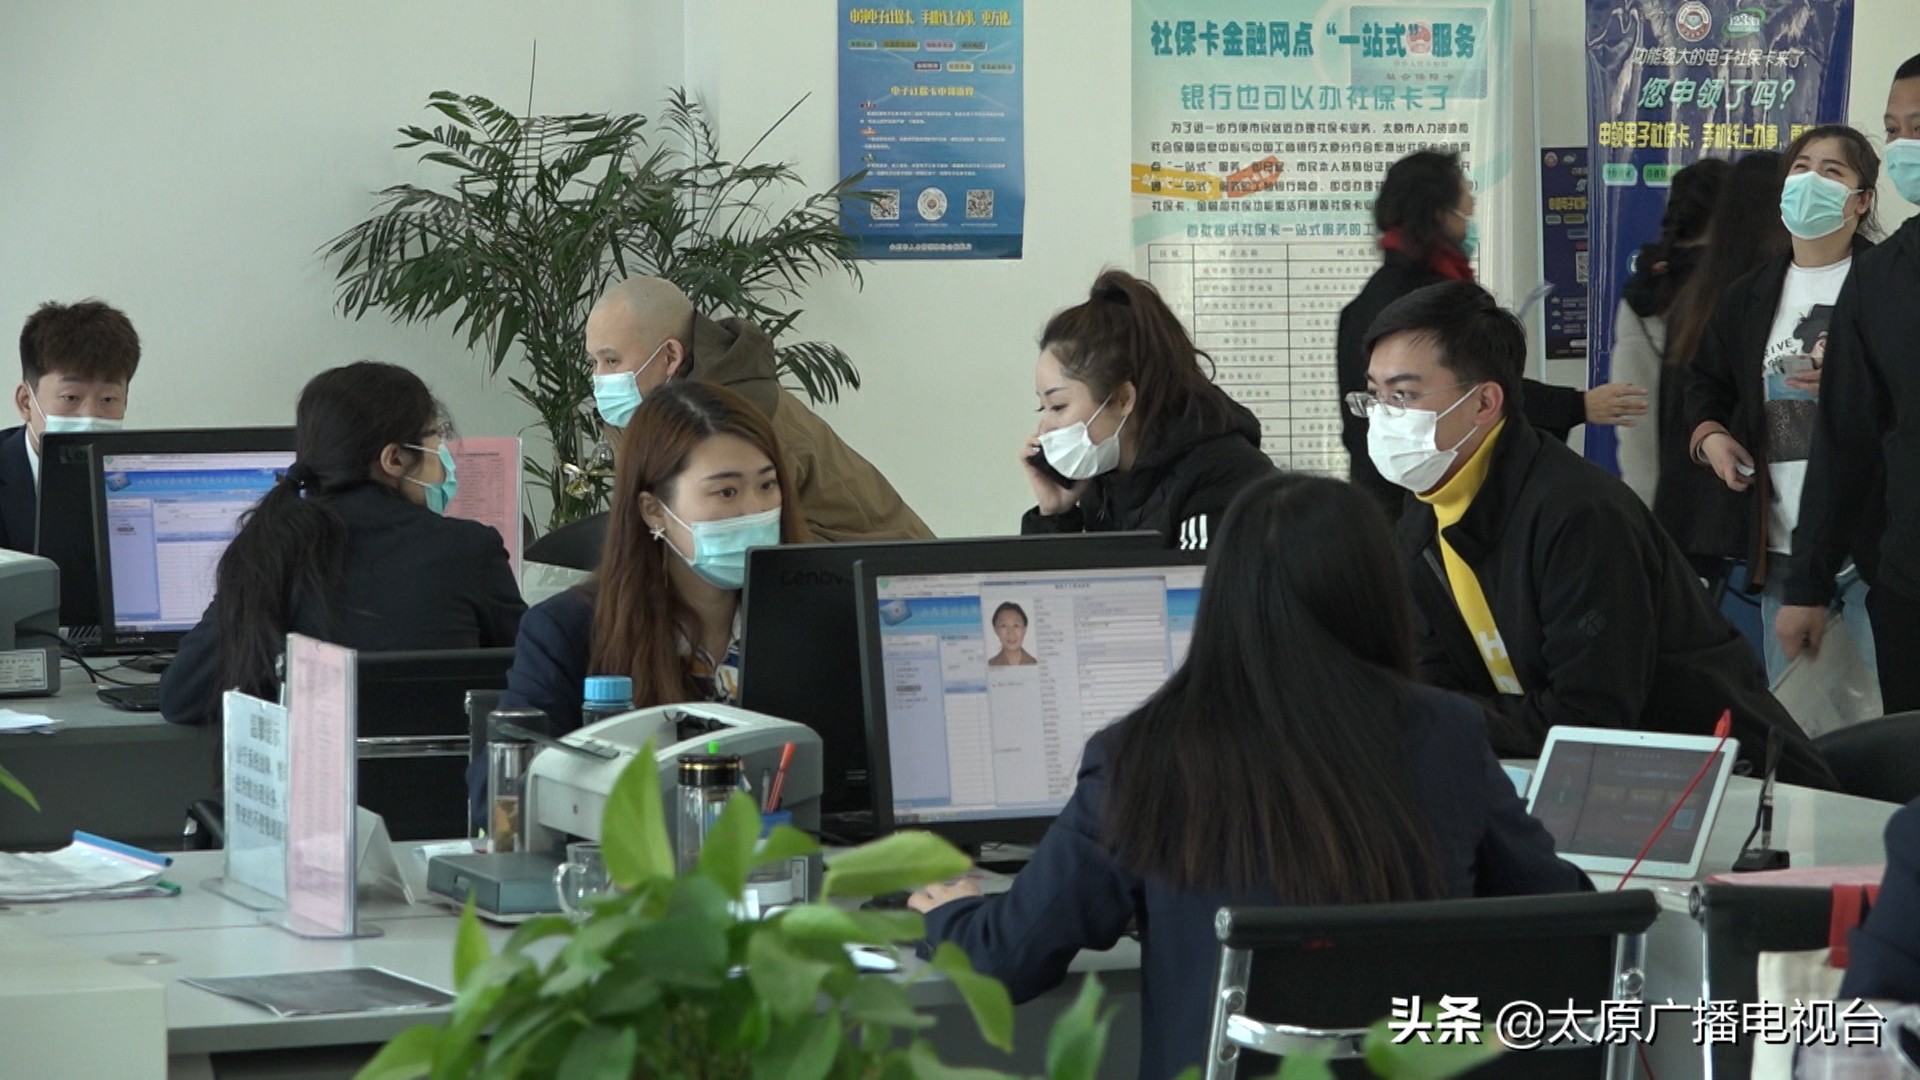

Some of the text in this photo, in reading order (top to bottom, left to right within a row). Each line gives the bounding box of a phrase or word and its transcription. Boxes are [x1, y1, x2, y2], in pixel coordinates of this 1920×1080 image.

[1181, 84, 1449, 111] 银行也可以办社保卡了
